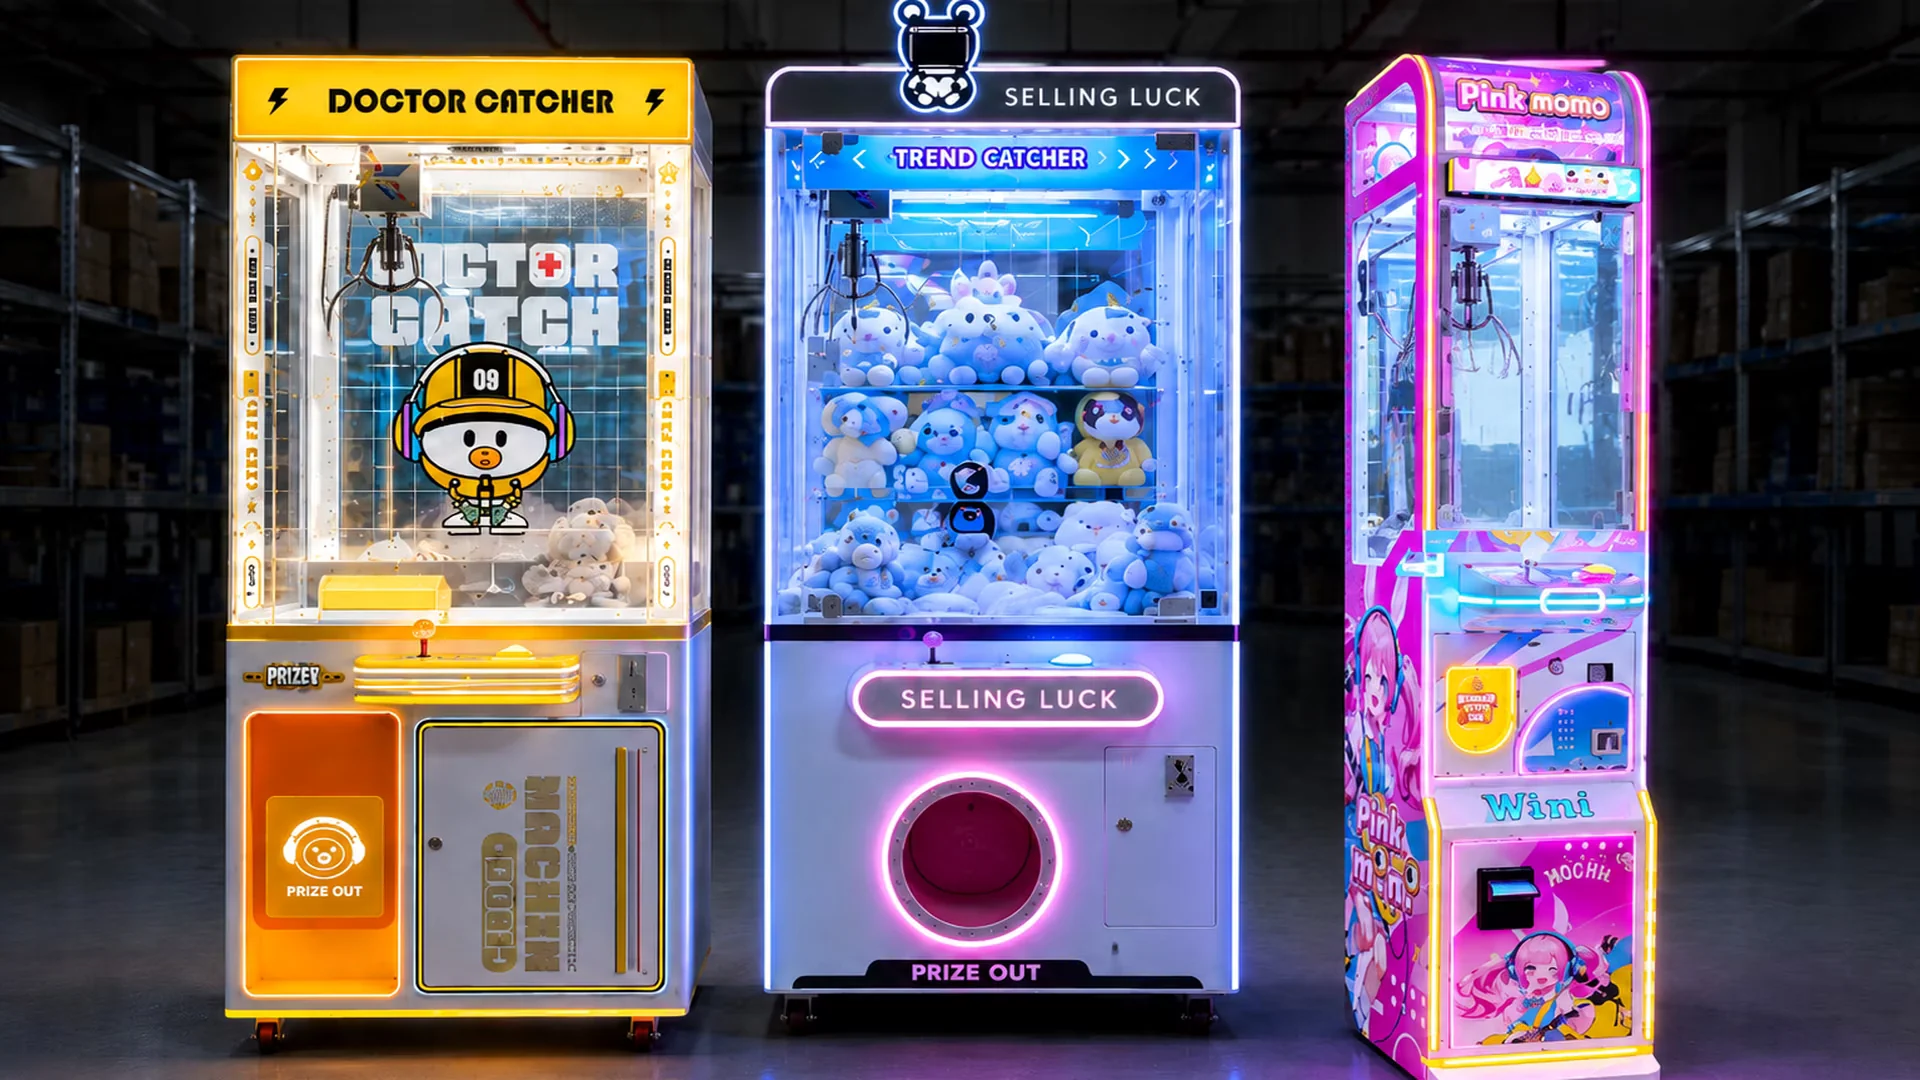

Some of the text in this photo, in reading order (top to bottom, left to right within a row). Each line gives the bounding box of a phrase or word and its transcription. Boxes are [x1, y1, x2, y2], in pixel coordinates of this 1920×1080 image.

[329, 88, 614, 114] DOCTOR CATCHER
[1004, 87, 1201, 107] SELLING LUCK
[1458, 80, 1609, 118] Pink momo
[893, 147, 1088, 169] TREND CATCHER
[371, 296, 620, 346] CATCH
[473, 368, 500, 392] 09
[900, 689, 1118, 710] SELLING LUCK
[1482, 790, 1595, 822] Wini
[286, 885, 364, 898] PRIZE OUT
[911, 963, 1042, 982] PRIZE OUT
